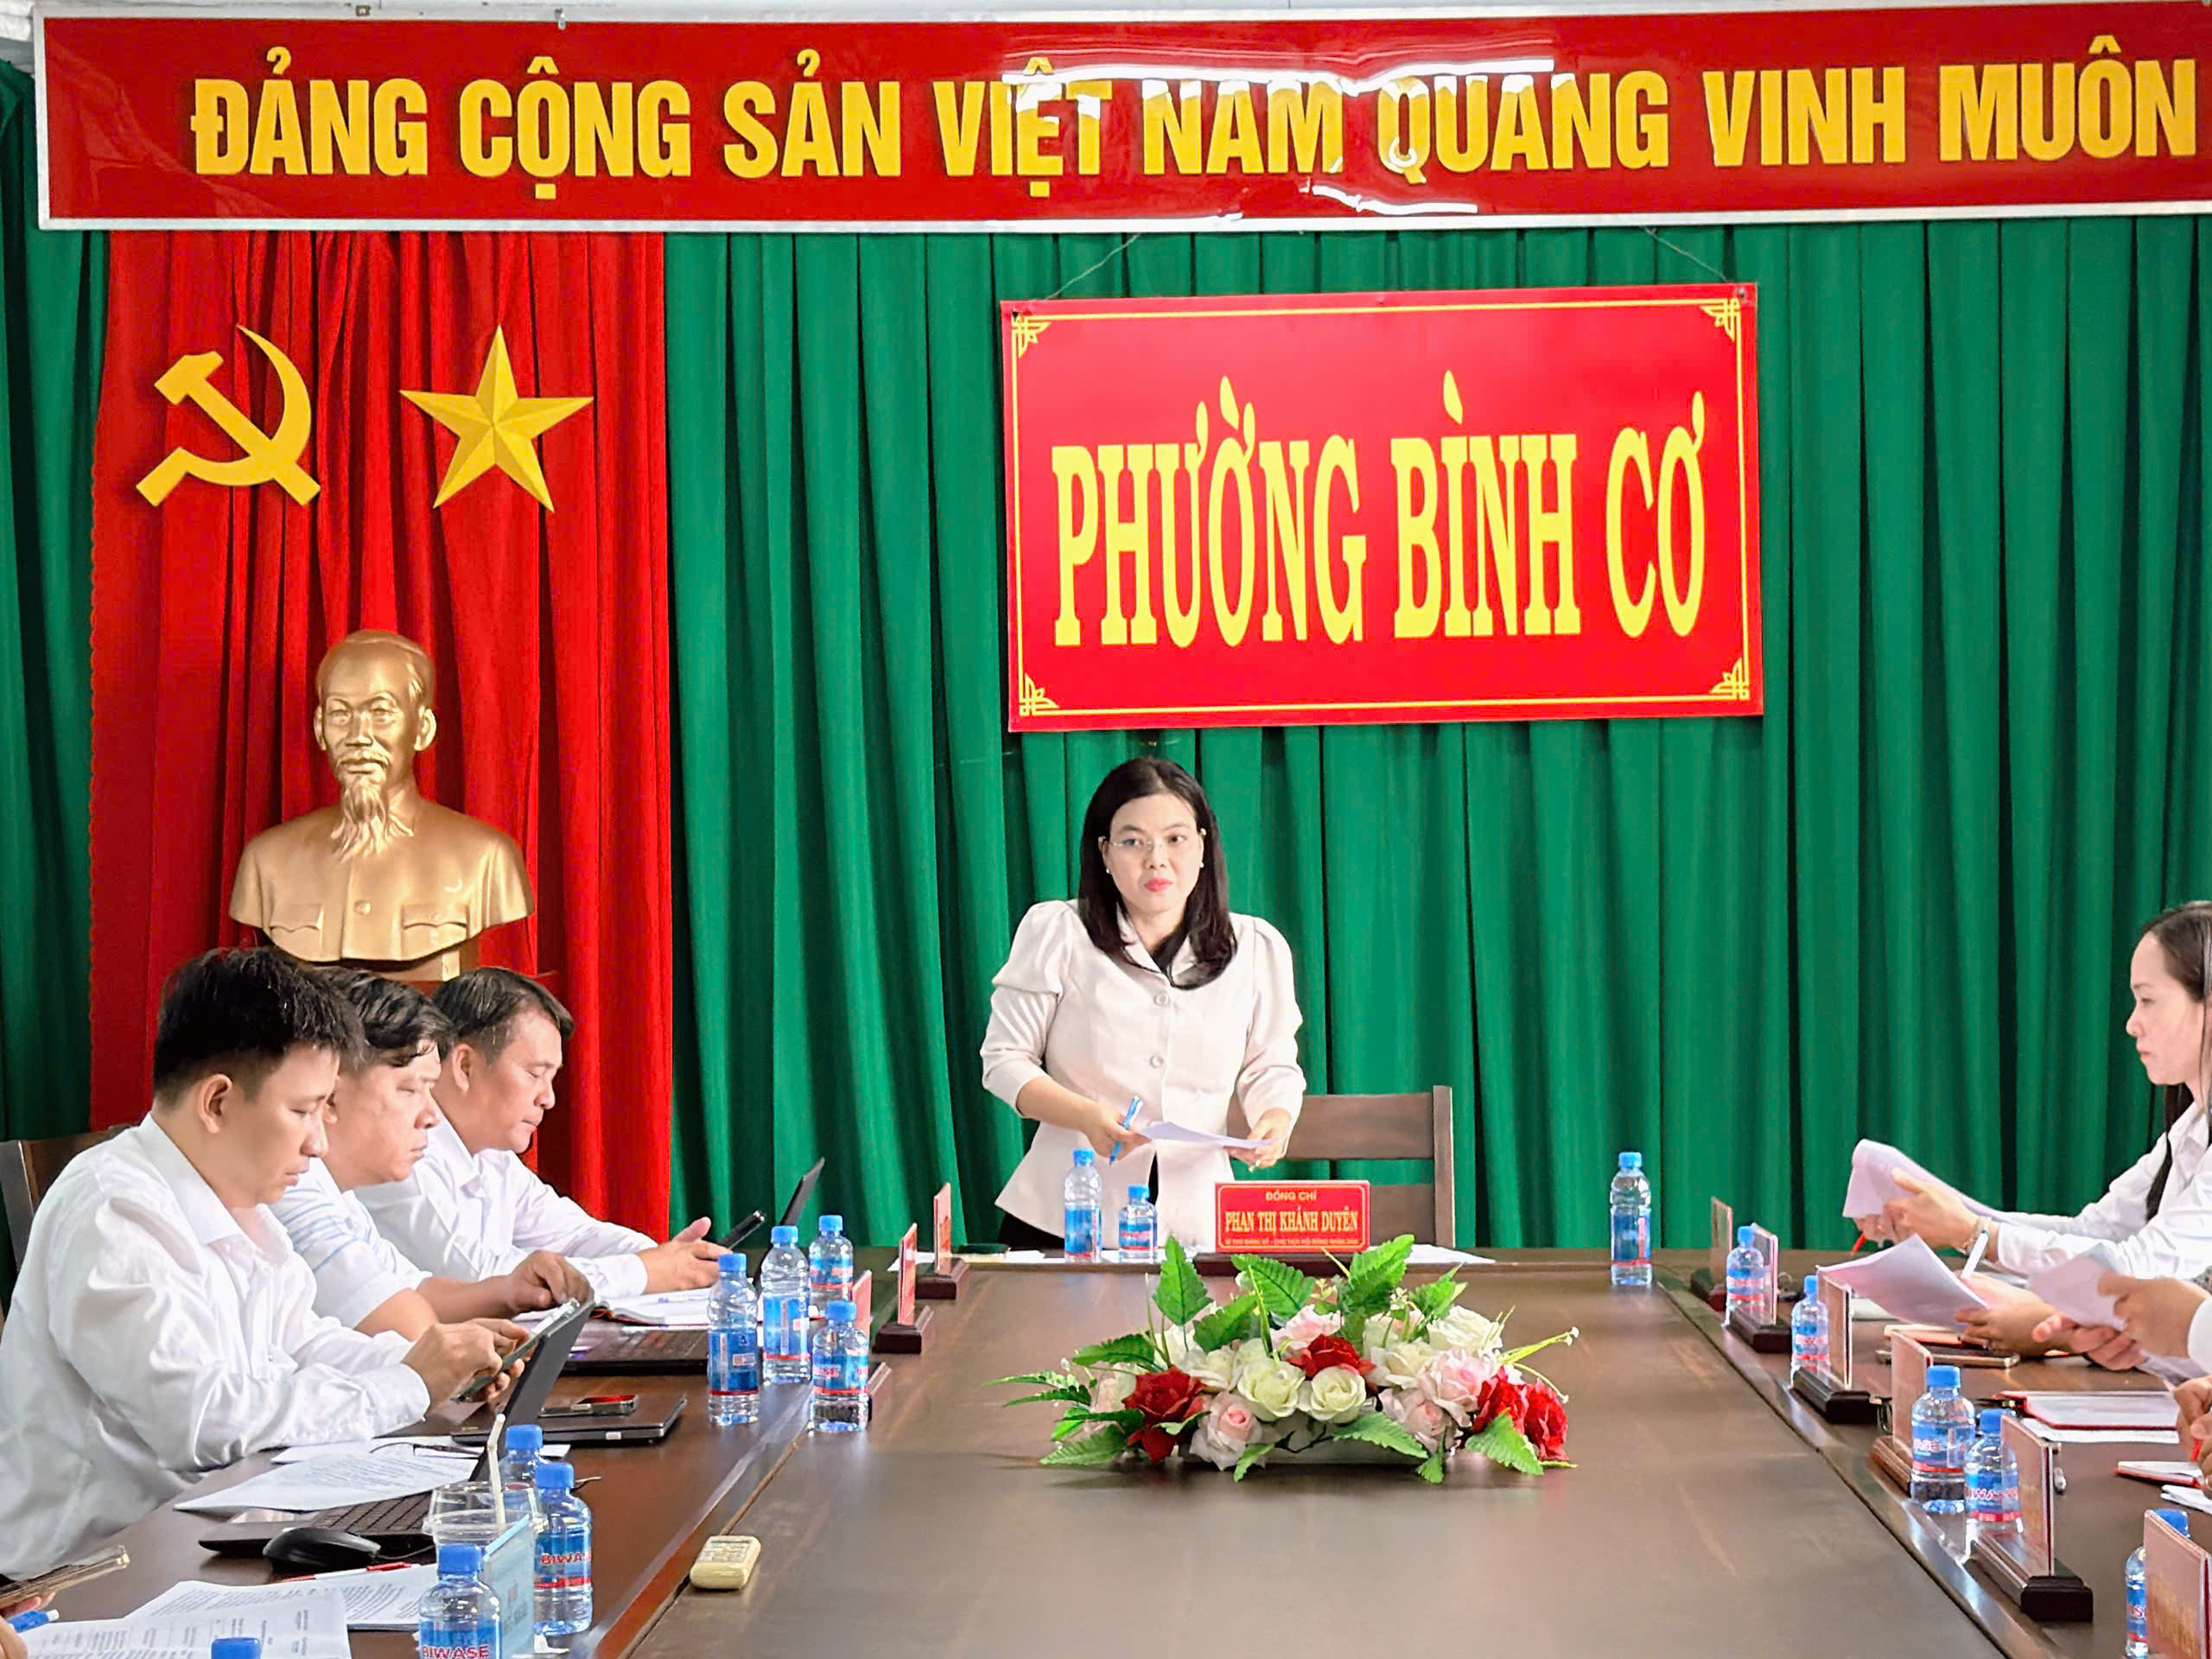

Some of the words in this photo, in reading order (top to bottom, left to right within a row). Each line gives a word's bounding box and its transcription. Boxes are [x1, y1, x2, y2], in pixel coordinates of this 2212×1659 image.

[190, 46, 428, 176] ĐẢNG
[459, 56, 690, 200] CỘNG
[723, 48, 901, 178] SẢN
[933, 57, 1113, 198] VIỆT
[1142, 79, 1344, 175] NAM
[1377, 71, 1669, 184] QUANG
[1702, 67, 1906, 167] VINH
[1939, 35, 2196, 162] MUÔN
[1052, 375, 1367, 648] PHƯỜNG
[1391, 370, 1581, 639] BÌNH
[1606, 391, 1706, 638] CƠ
[1298, 1189, 1317, 1202] CHÍ
[1224, 1211, 1255, 1232] PHAN
[1257, 1211, 1276, 1236] THỊ
[1279, 1205, 1319, 1232] KHÁNH
[541, 1551, 592, 1565] BIWA
[423, 1644, 490, 1659] BIWASE
